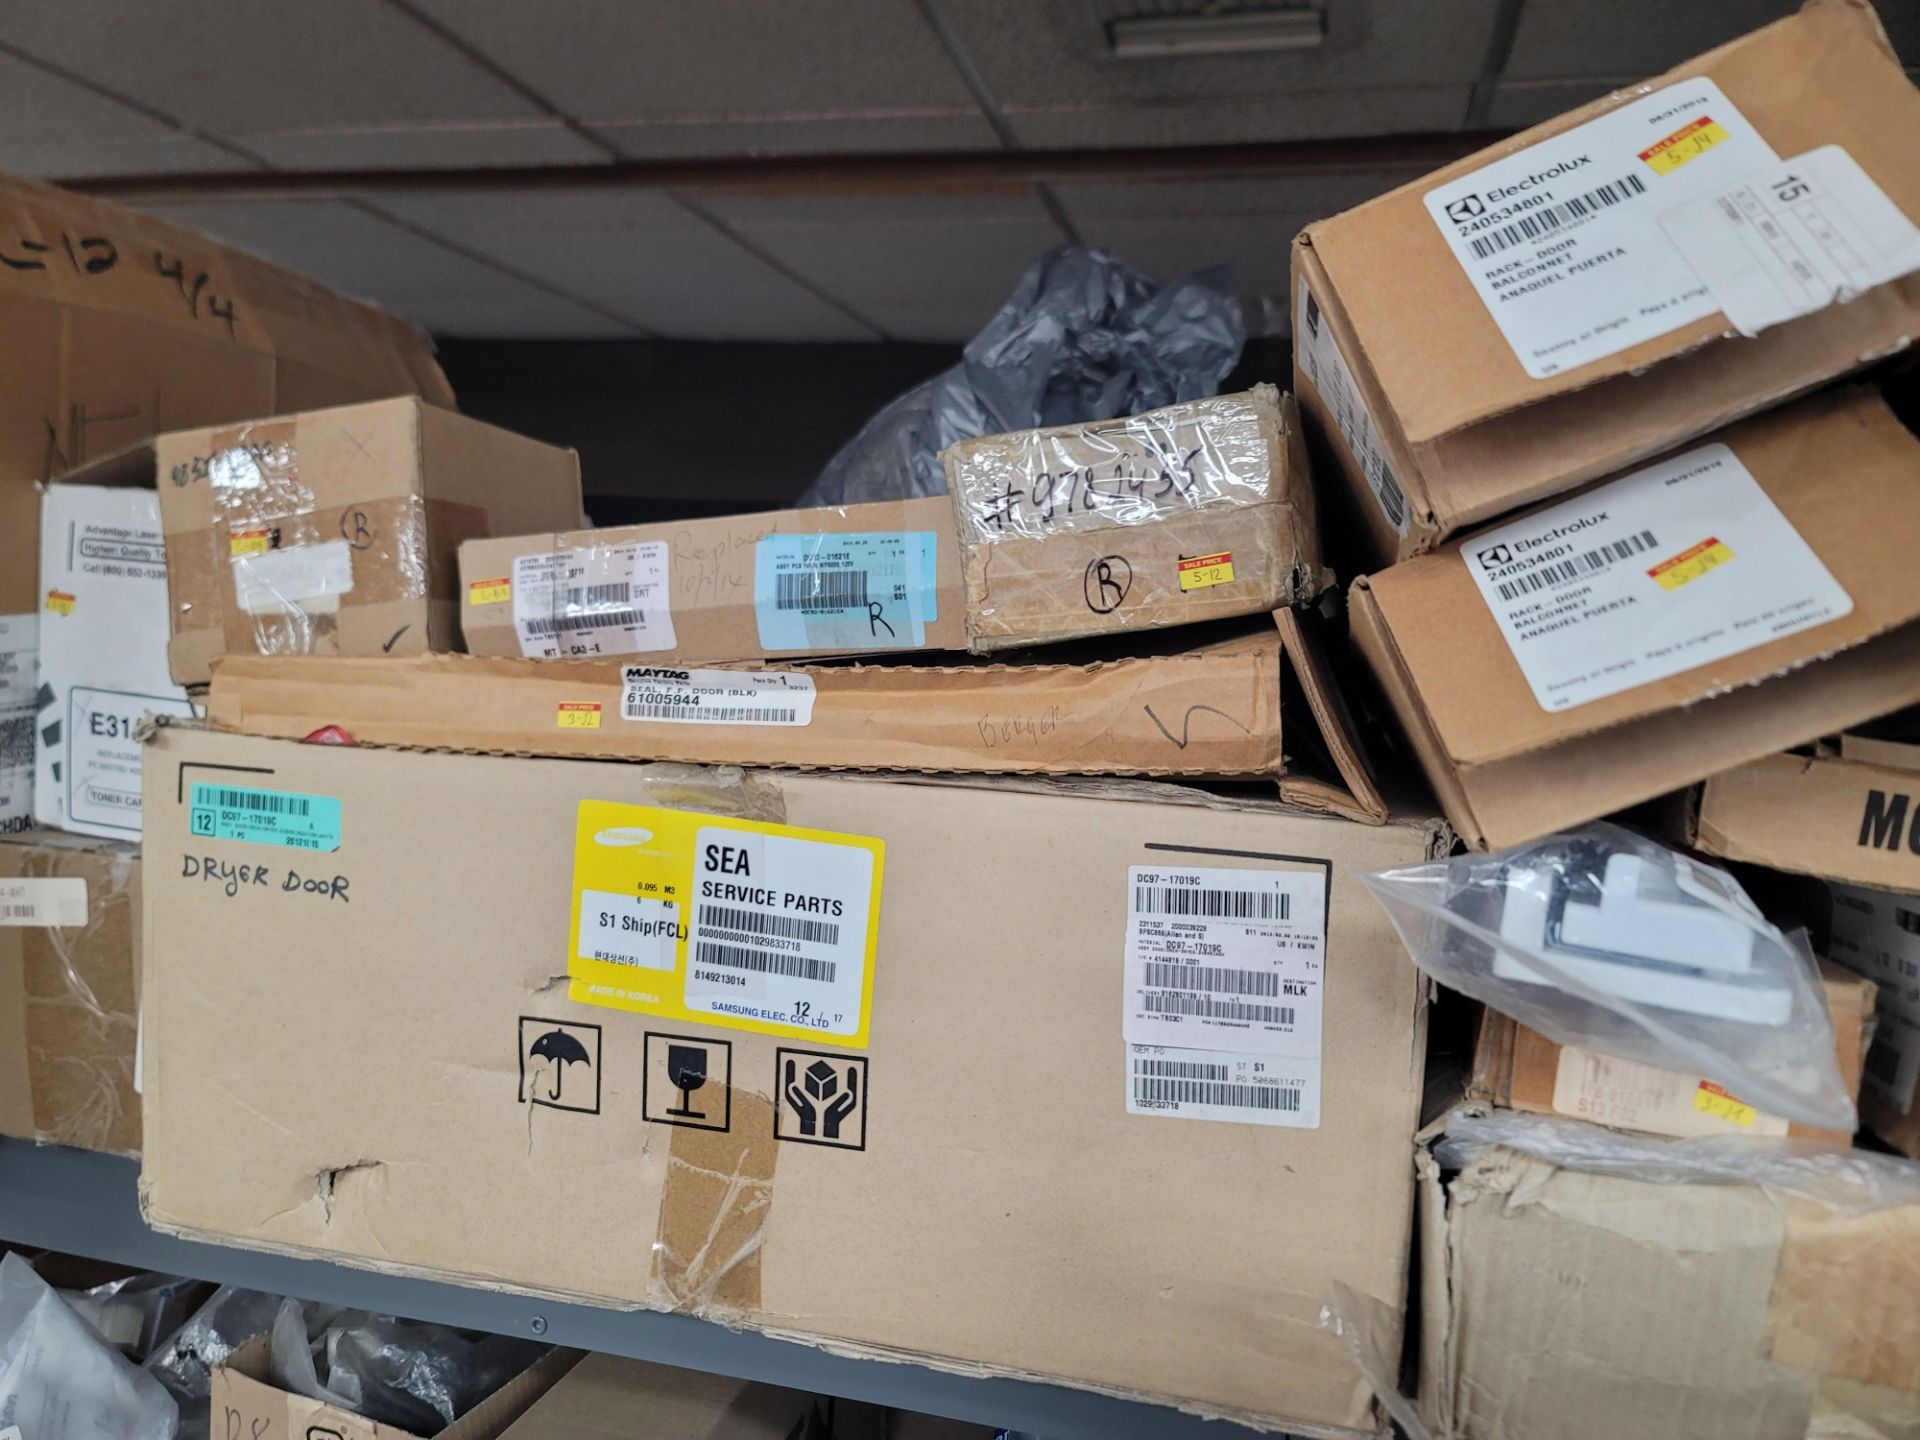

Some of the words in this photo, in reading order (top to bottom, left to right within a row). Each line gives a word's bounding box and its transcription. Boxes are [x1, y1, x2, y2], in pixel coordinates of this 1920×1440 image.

[1486, 153, 1593, 203] Electrolux
[1770, 175, 1810, 203] 15
[1458, 191, 1556, 238] 240534801
[85, 525, 134, 540] Advantage
[1514, 511, 1611, 554] Electrolux
[121, 545, 152, 561] Quality
[1183, 558, 1204, 570] SALE
[1204, 555, 1223, 567] PRICE
[867, 601, 896, 638] R
[626, 668, 690, 680] MAYTAG
[779, 675, 787, 686] 1
[627, 692, 701, 706] 61005944
[692, 687, 724, 696] DOOR
[728, 688, 758, 698] (BLK)
[91, 790, 123, 805] TONER
[196, 814, 212, 831] 12
[704, 843, 751, 877] SEA
[637, 881, 658, 892] 0.095
[664, 885, 676, 895] M3
[663, 899, 674, 909] KG
[701, 880, 777, 907] SERVICE
[783, 893, 843, 917] PARTS
[599, 911, 616, 929] S1
[621, 914, 689, 943] Ship(FCL)
[694, 969, 746, 987] 8149213014
[588, 983, 614, 997] MADE
[615, 988, 626, 998] IN
[627, 990, 660, 1004] KOREA
[1283, 984, 1308, 997] MLK
[711, 1000, 759, 1018] SAMSUNG
[760, 1008, 789, 1022] ELEC.
[794, 1000, 811, 1017] 12
[1254, 1062, 1265, 1072] S1
